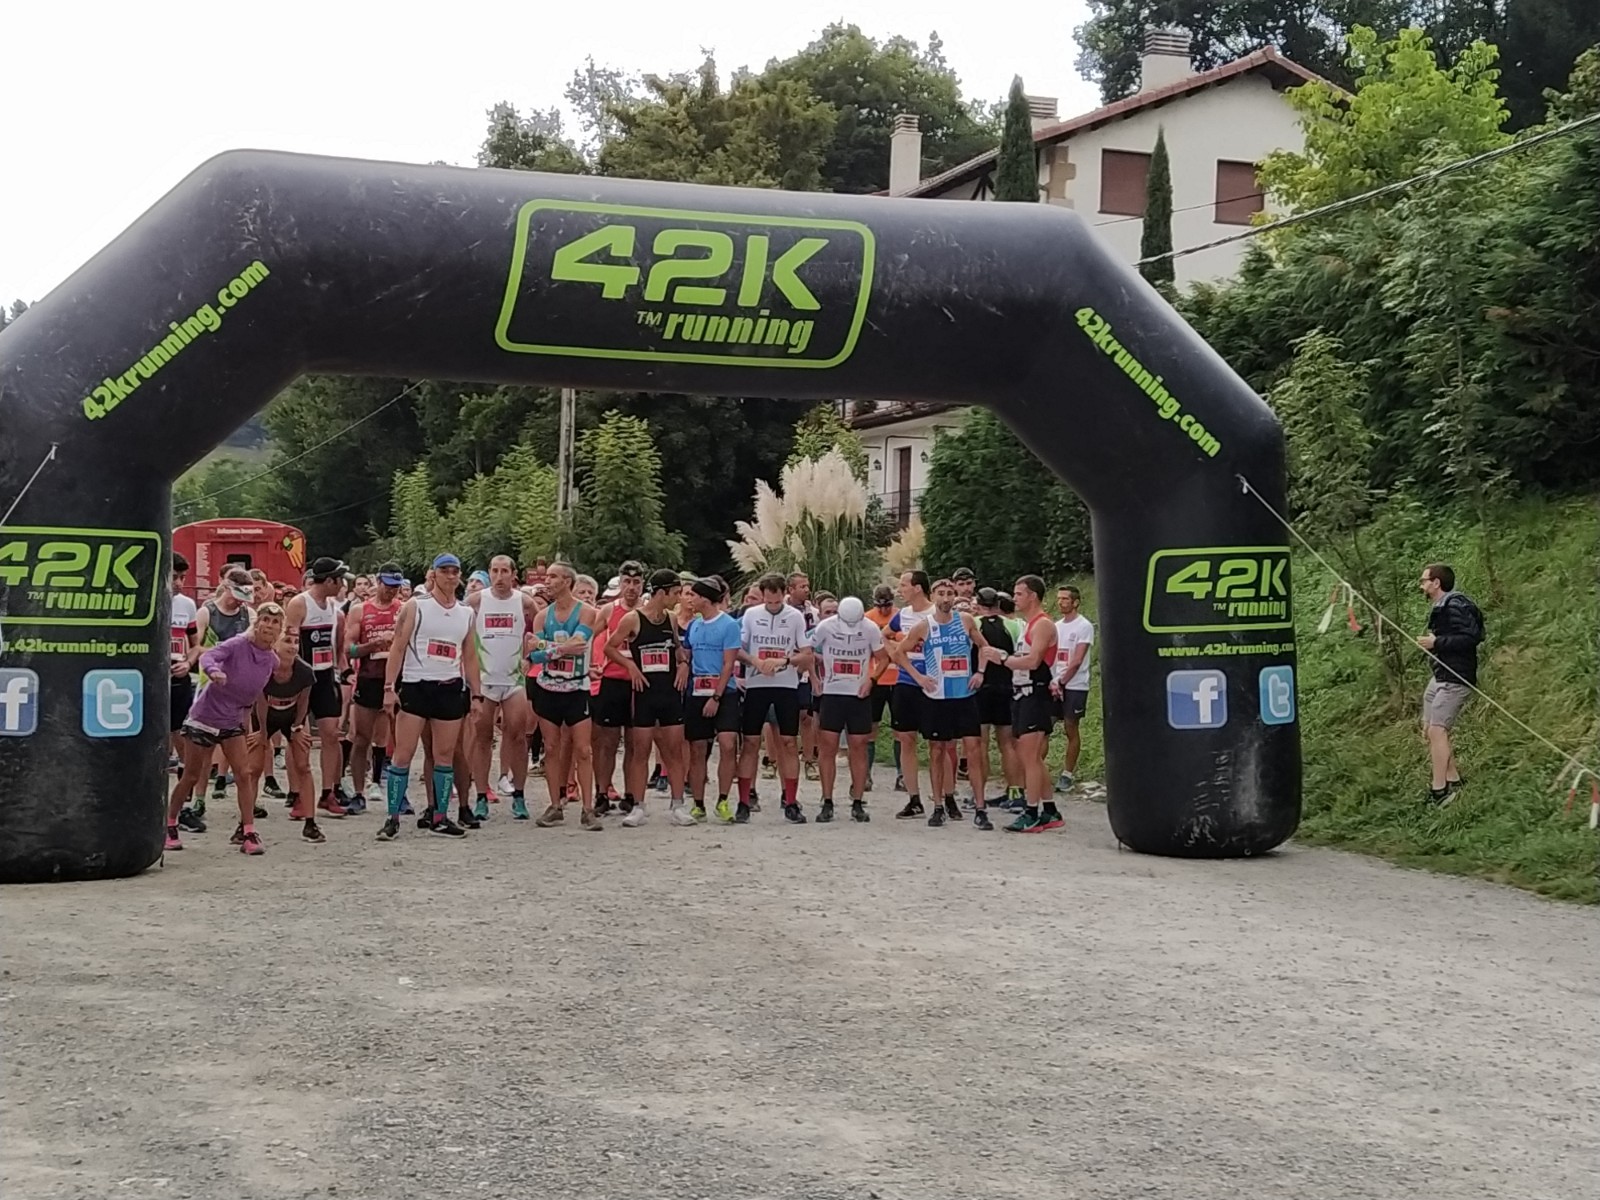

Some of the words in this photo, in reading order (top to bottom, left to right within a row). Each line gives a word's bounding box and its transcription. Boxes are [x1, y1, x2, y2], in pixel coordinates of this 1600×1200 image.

[551, 225, 829, 310] 42K
[83, 260, 270, 420] 42krunning.com
[662, 309, 814, 353] running
[1074, 307, 1221, 457] 42krunning.com
[1166, 558, 1288, 599] 42K
[45, 588, 137, 616] running
[1228, 597, 1286, 619] running
